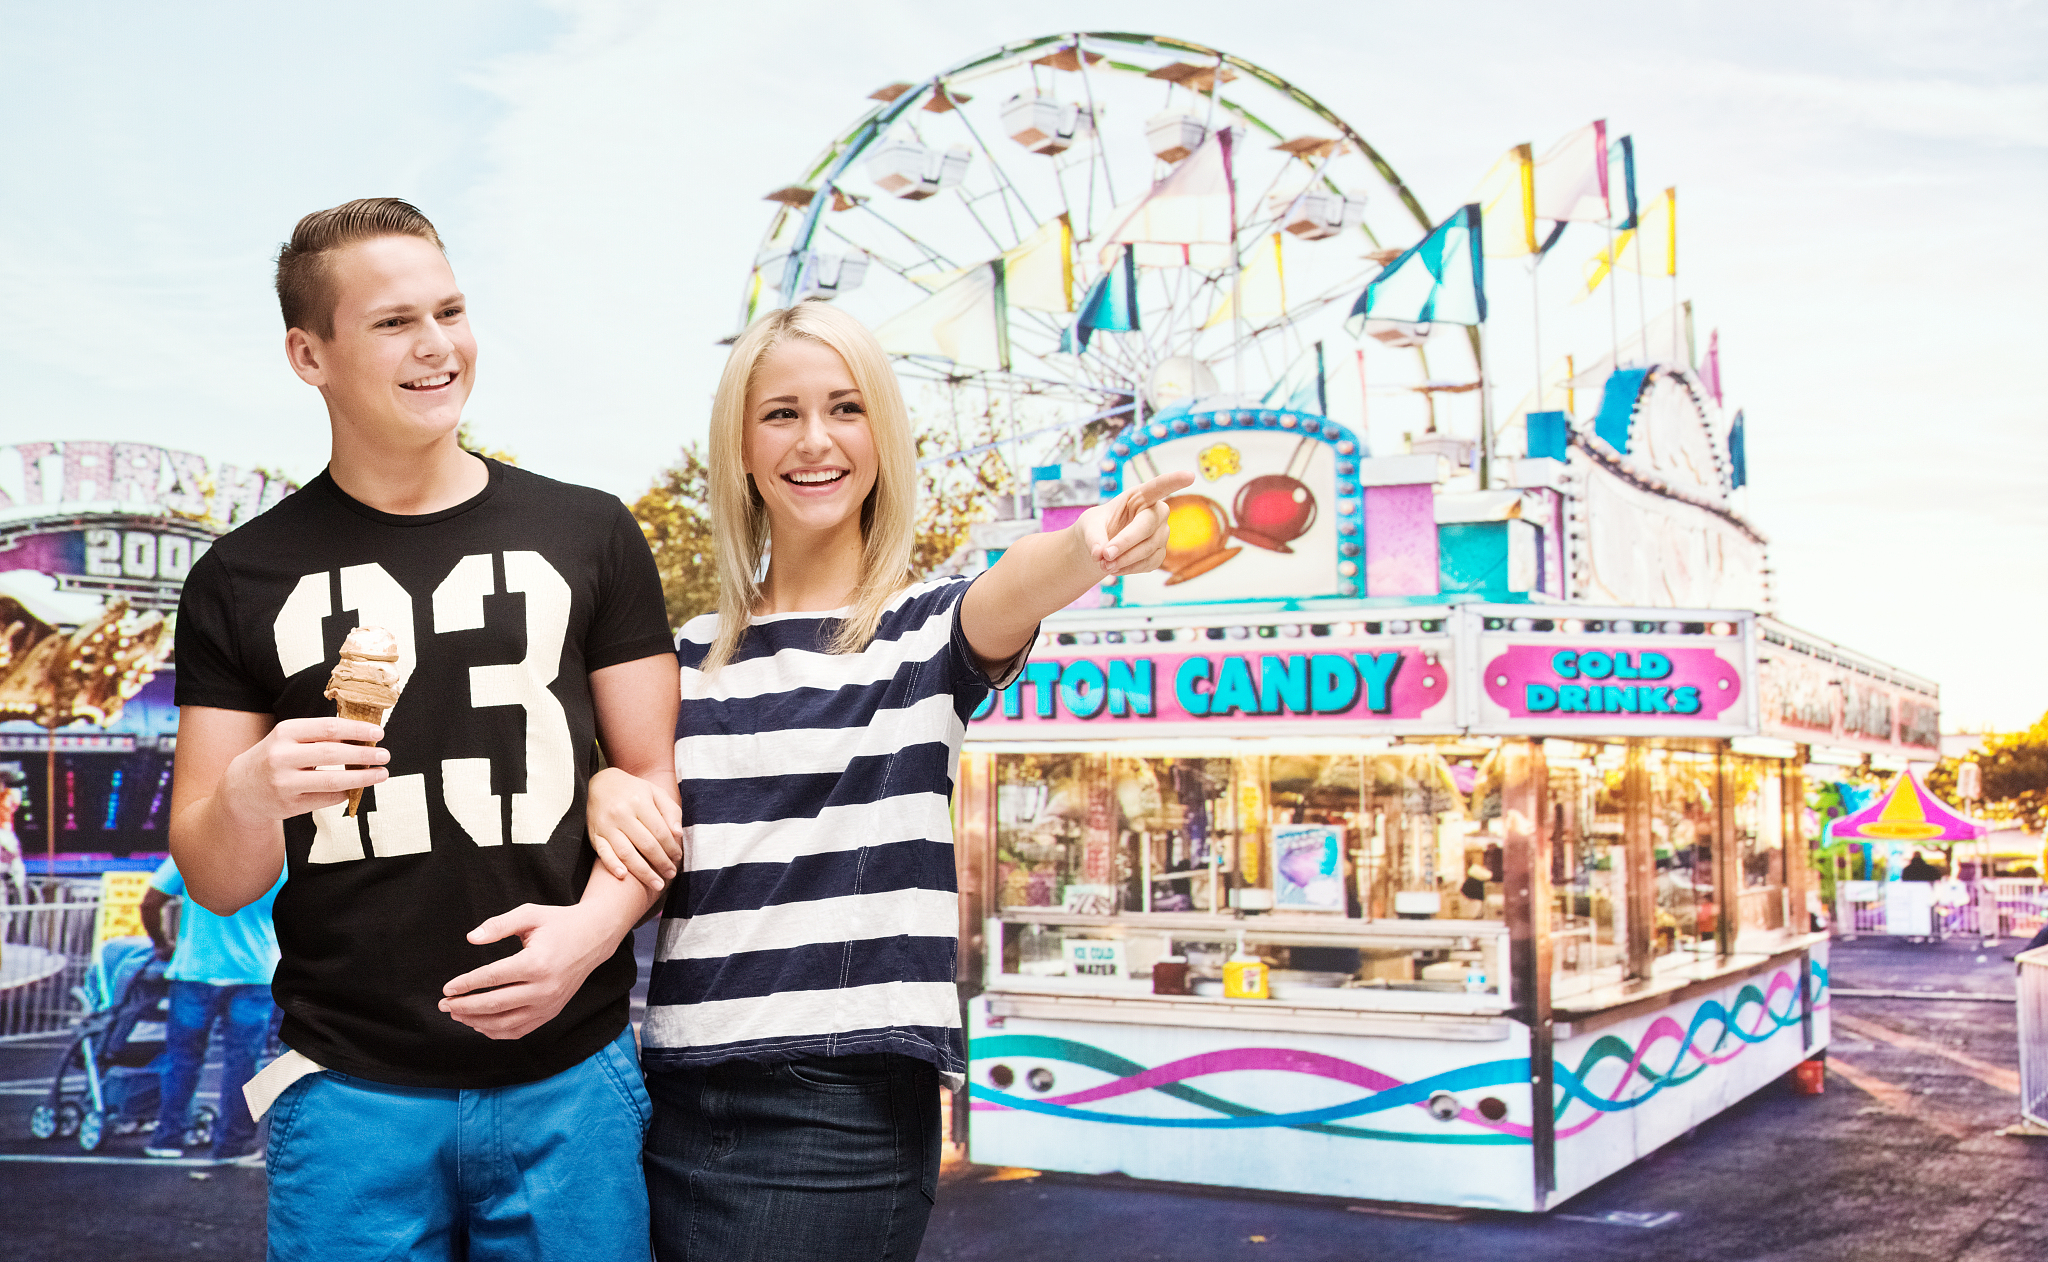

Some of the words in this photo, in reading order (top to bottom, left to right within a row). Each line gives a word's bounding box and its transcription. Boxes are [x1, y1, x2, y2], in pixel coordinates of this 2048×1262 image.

[1175, 652, 1406, 718] CANDY
[1552, 650, 1673, 680] COLD
[273, 550, 575, 864] 23
[1526, 684, 1702, 715] DRINKS
